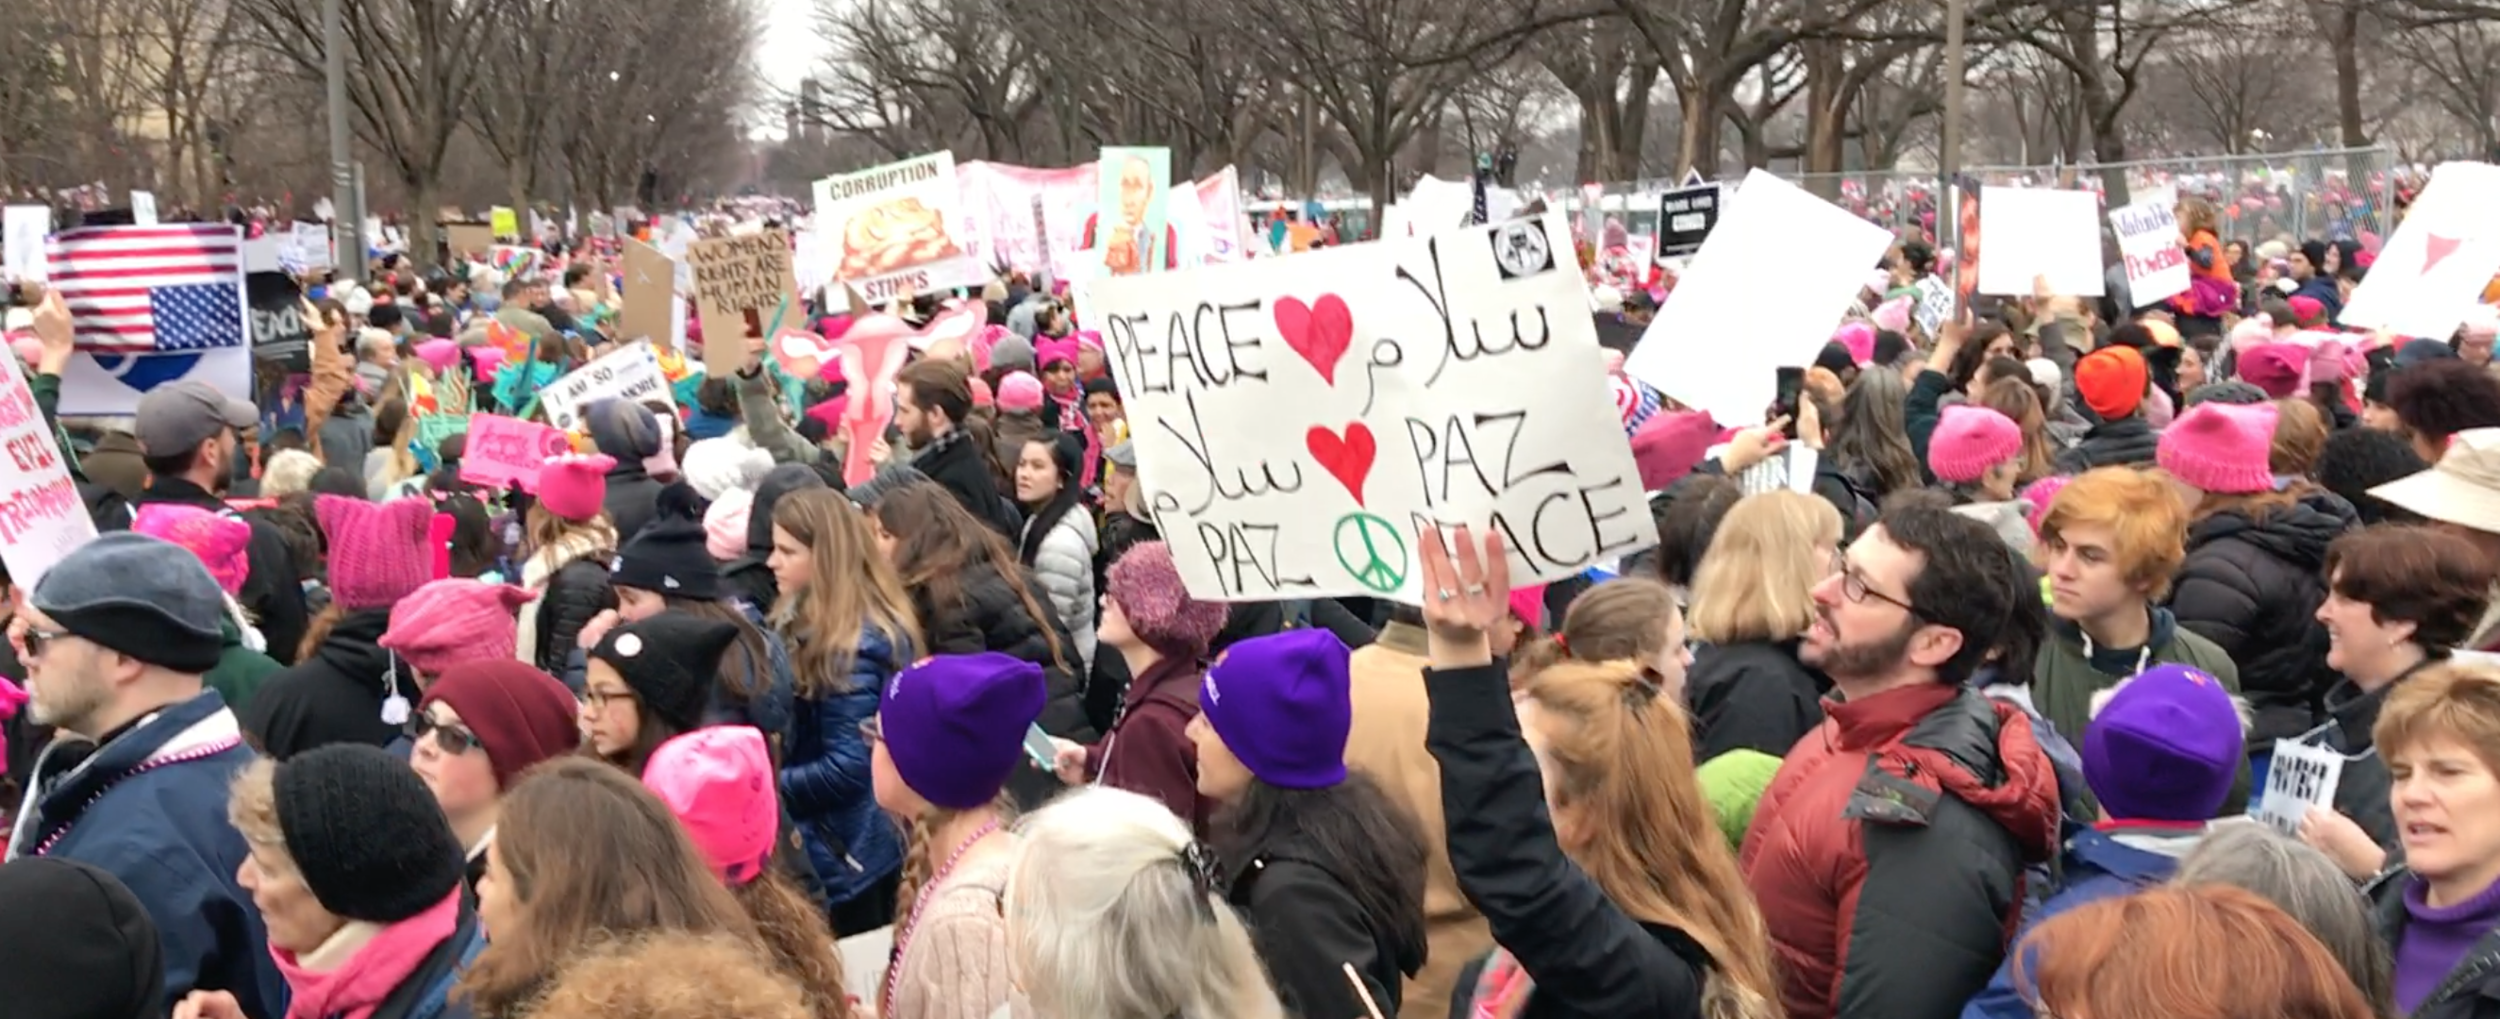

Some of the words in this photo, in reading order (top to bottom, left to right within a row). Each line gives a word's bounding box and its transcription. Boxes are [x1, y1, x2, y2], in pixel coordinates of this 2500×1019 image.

[829, 159, 939, 201] CORRUPTION
[696, 259, 750, 283] RIGHTS
[755, 252, 786, 275] ARE
[700, 272, 782, 301] HUMAN
[716, 291, 782, 316] RIGHTS
[1360, 235, 1550, 417] سلام
[1107, 297, 1269, 400] PEACE
[591, 365, 614, 386] SO
[6, 430, 55, 473] EVIL
[1152, 384, 1303, 559] سلام
[1404, 408, 1578, 509] PAZ
[1197, 518, 1320, 598] PAZ
